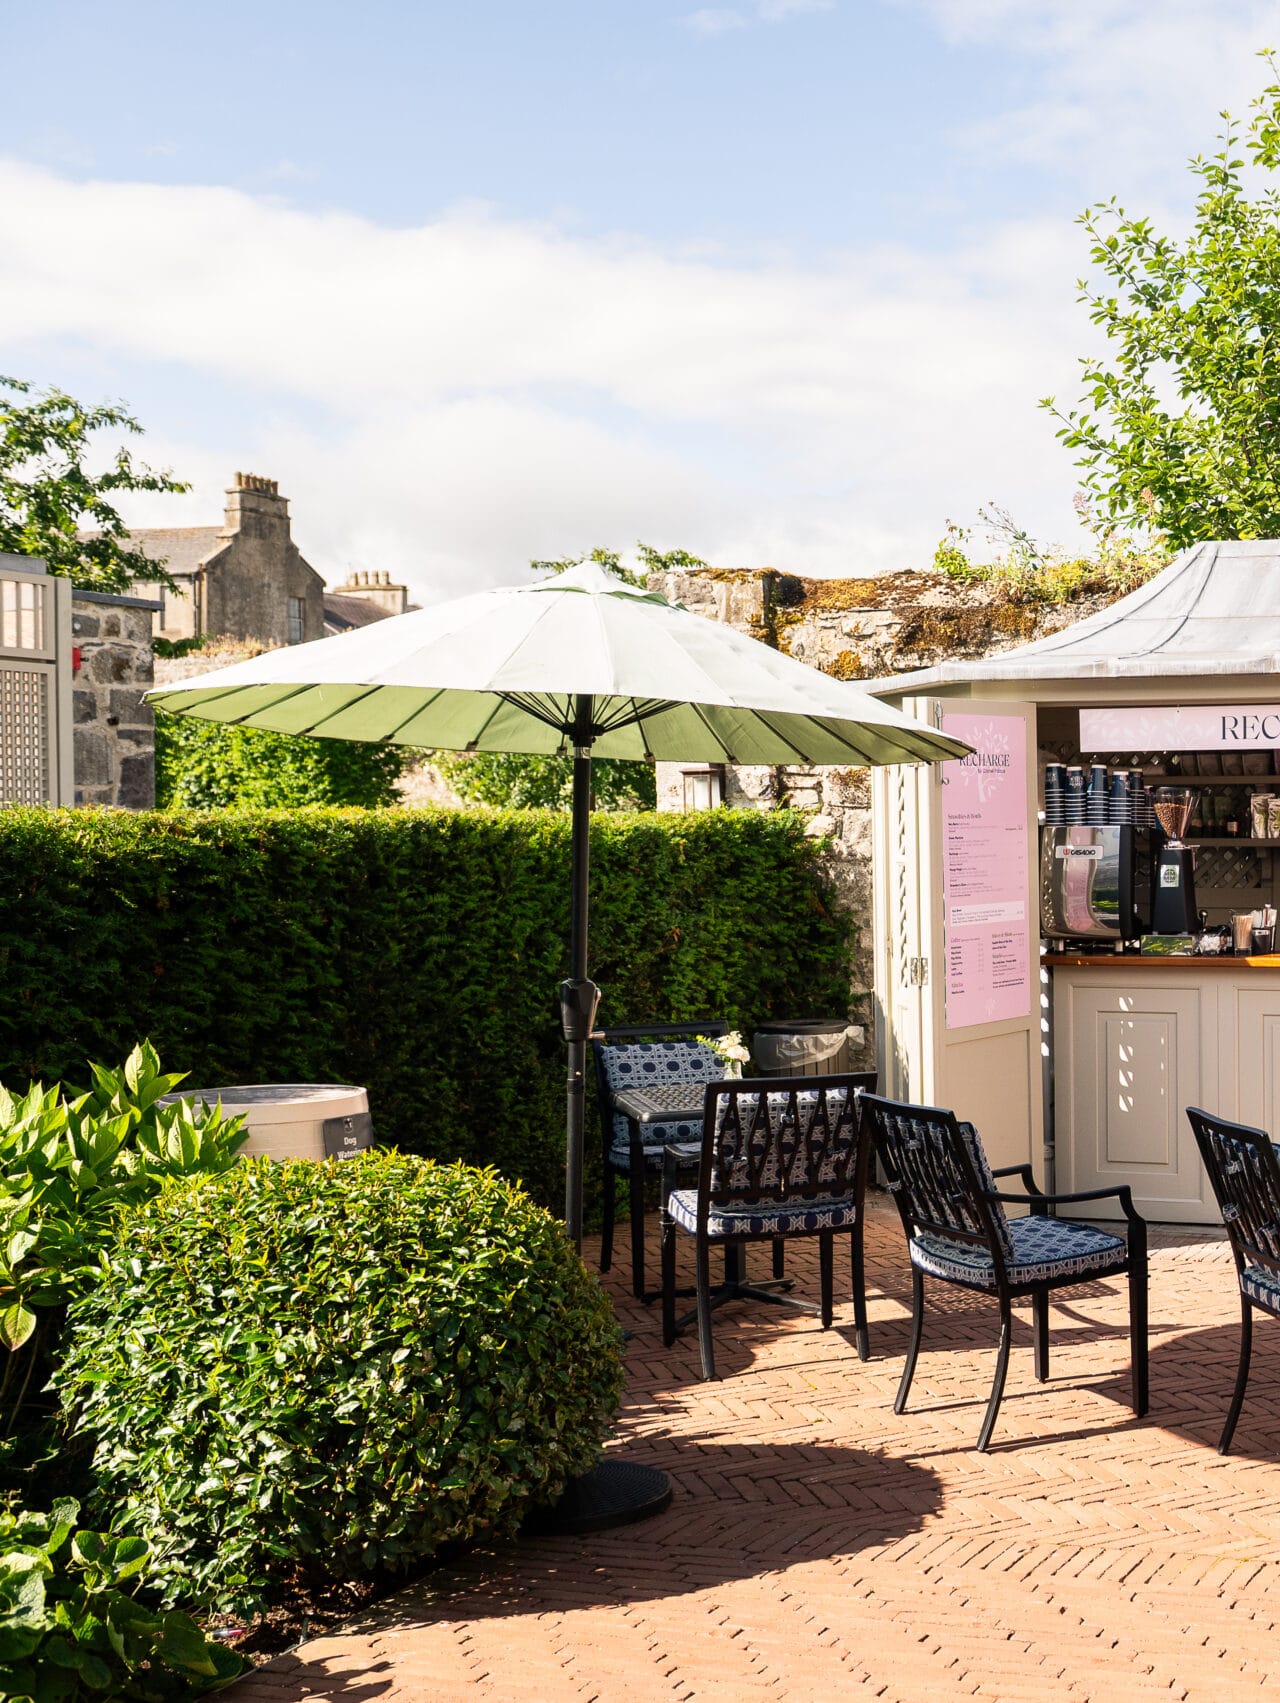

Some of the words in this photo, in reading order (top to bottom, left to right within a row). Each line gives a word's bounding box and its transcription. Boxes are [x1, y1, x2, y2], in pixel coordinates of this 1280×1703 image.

[959, 753, 1010, 767] RECHARGE
[1070, 848, 1096, 856] CASADIO
[344, 1137, 357, 1146] Dog
